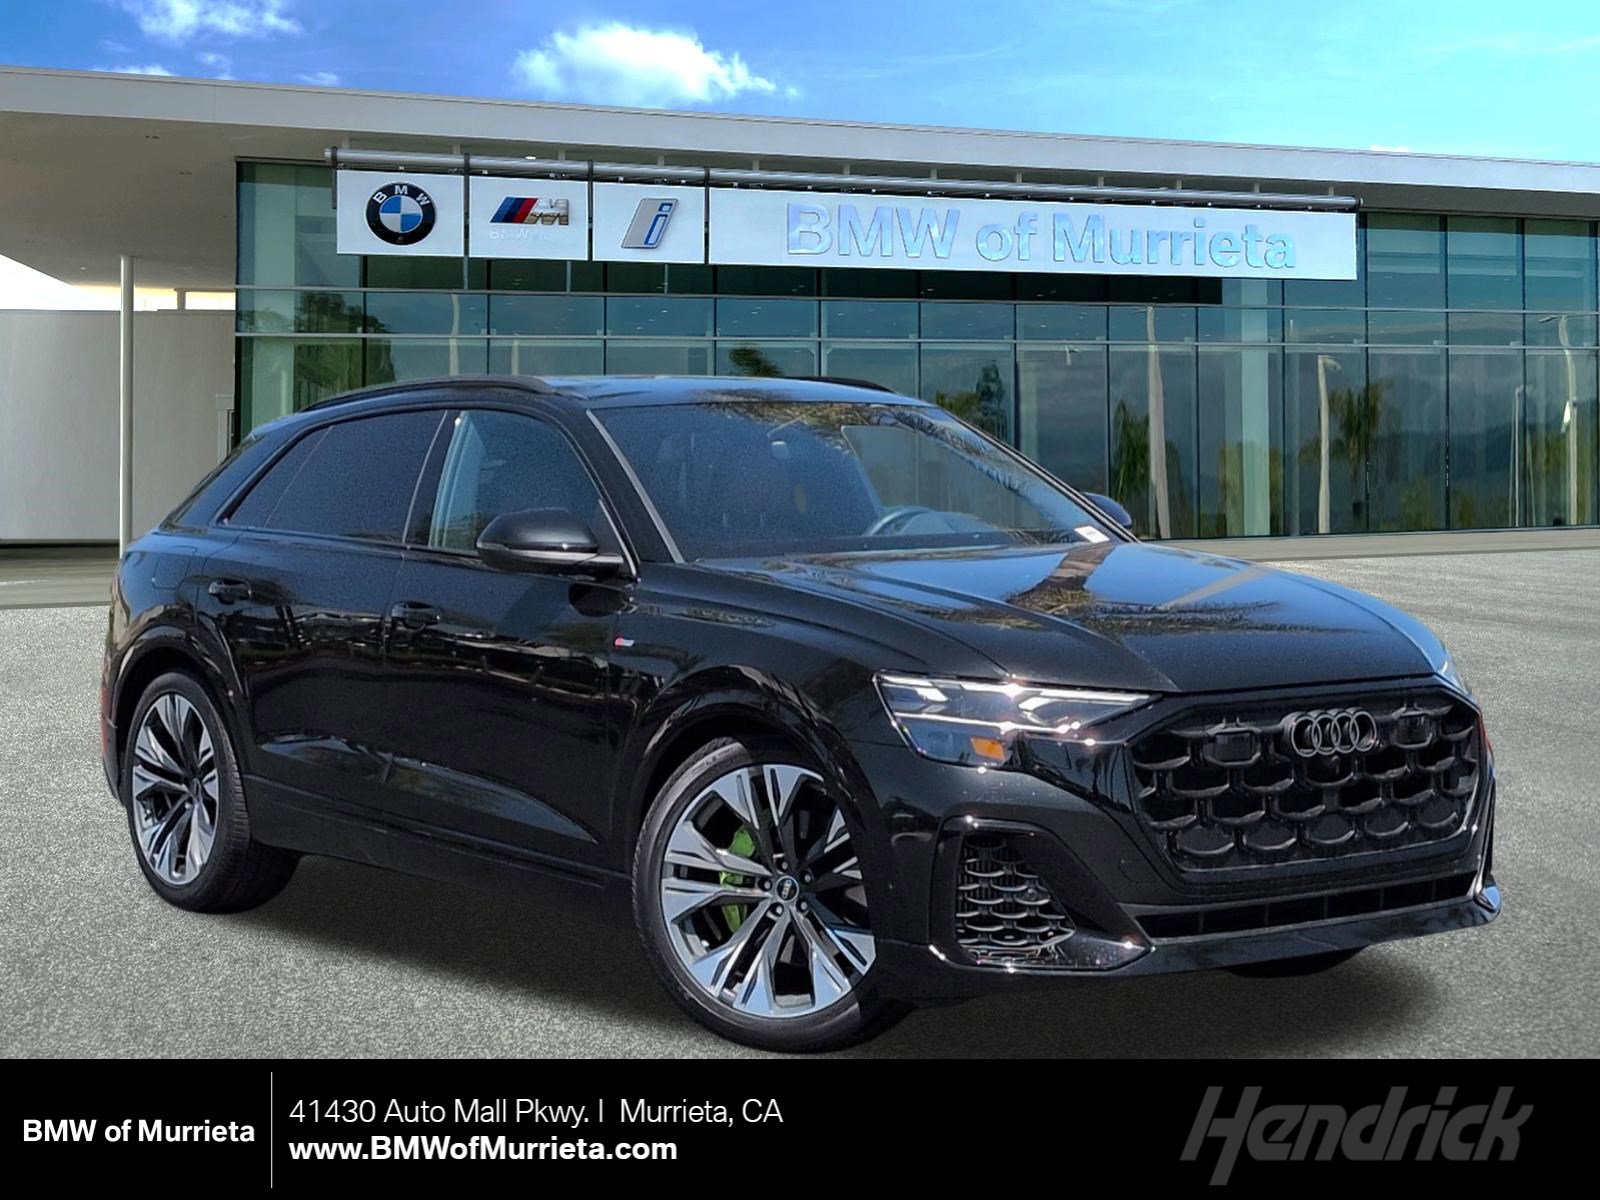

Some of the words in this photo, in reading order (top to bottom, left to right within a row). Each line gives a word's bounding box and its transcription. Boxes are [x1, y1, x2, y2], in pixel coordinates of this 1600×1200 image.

[372, 184, 431, 206] BMW
[787, 202, 961, 259] BMW
[975, 211, 1039, 262] of
[1052, 212, 1296, 269] Murrieta
